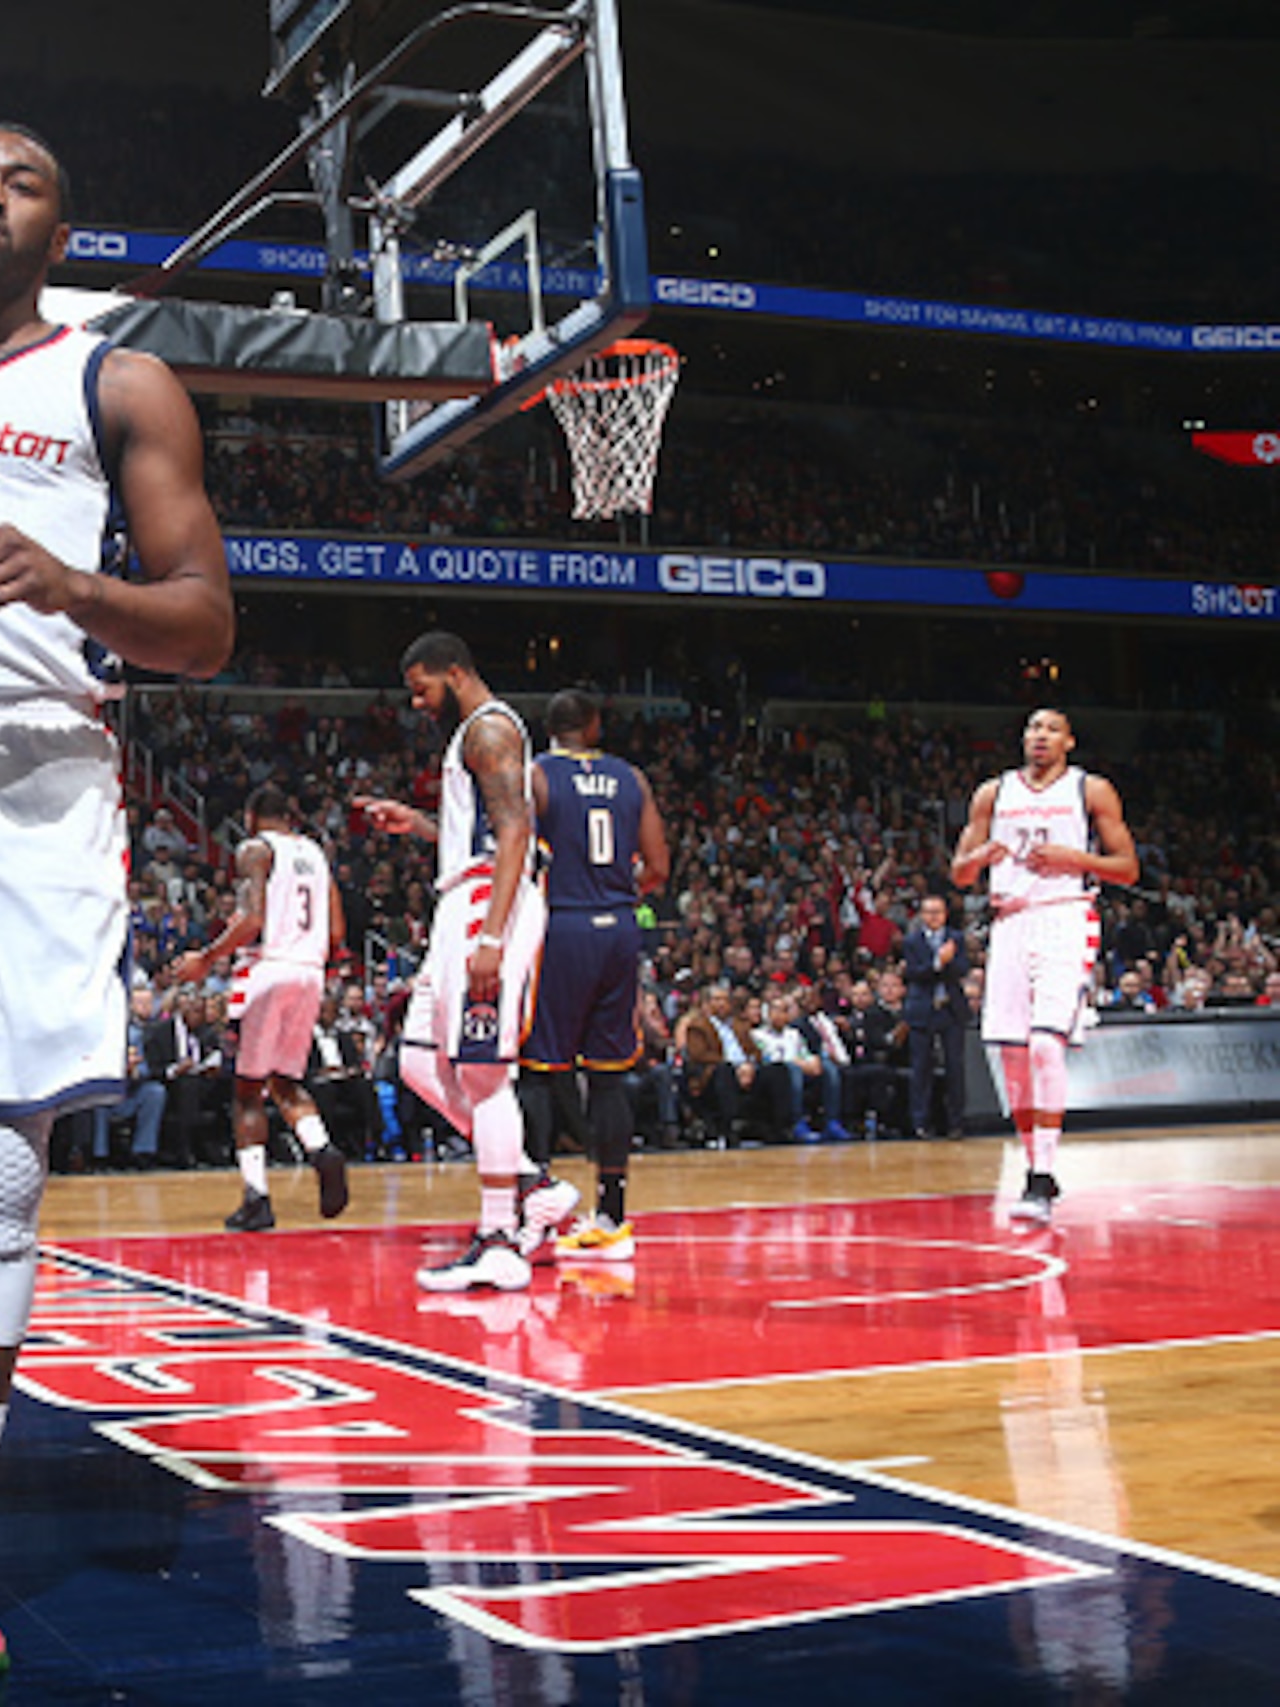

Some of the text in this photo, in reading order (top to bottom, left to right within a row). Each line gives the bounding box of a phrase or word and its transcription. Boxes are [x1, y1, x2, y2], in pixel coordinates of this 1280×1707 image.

[656, 278, 757, 309] GEICO
[227, 540, 826, 598] NGS. GET A QUOTE FROM GEICO
[1191, 584, 1277, 615] SHOOT
[587, 808, 614, 866] 0
[297, 883, 312, 932] 3
